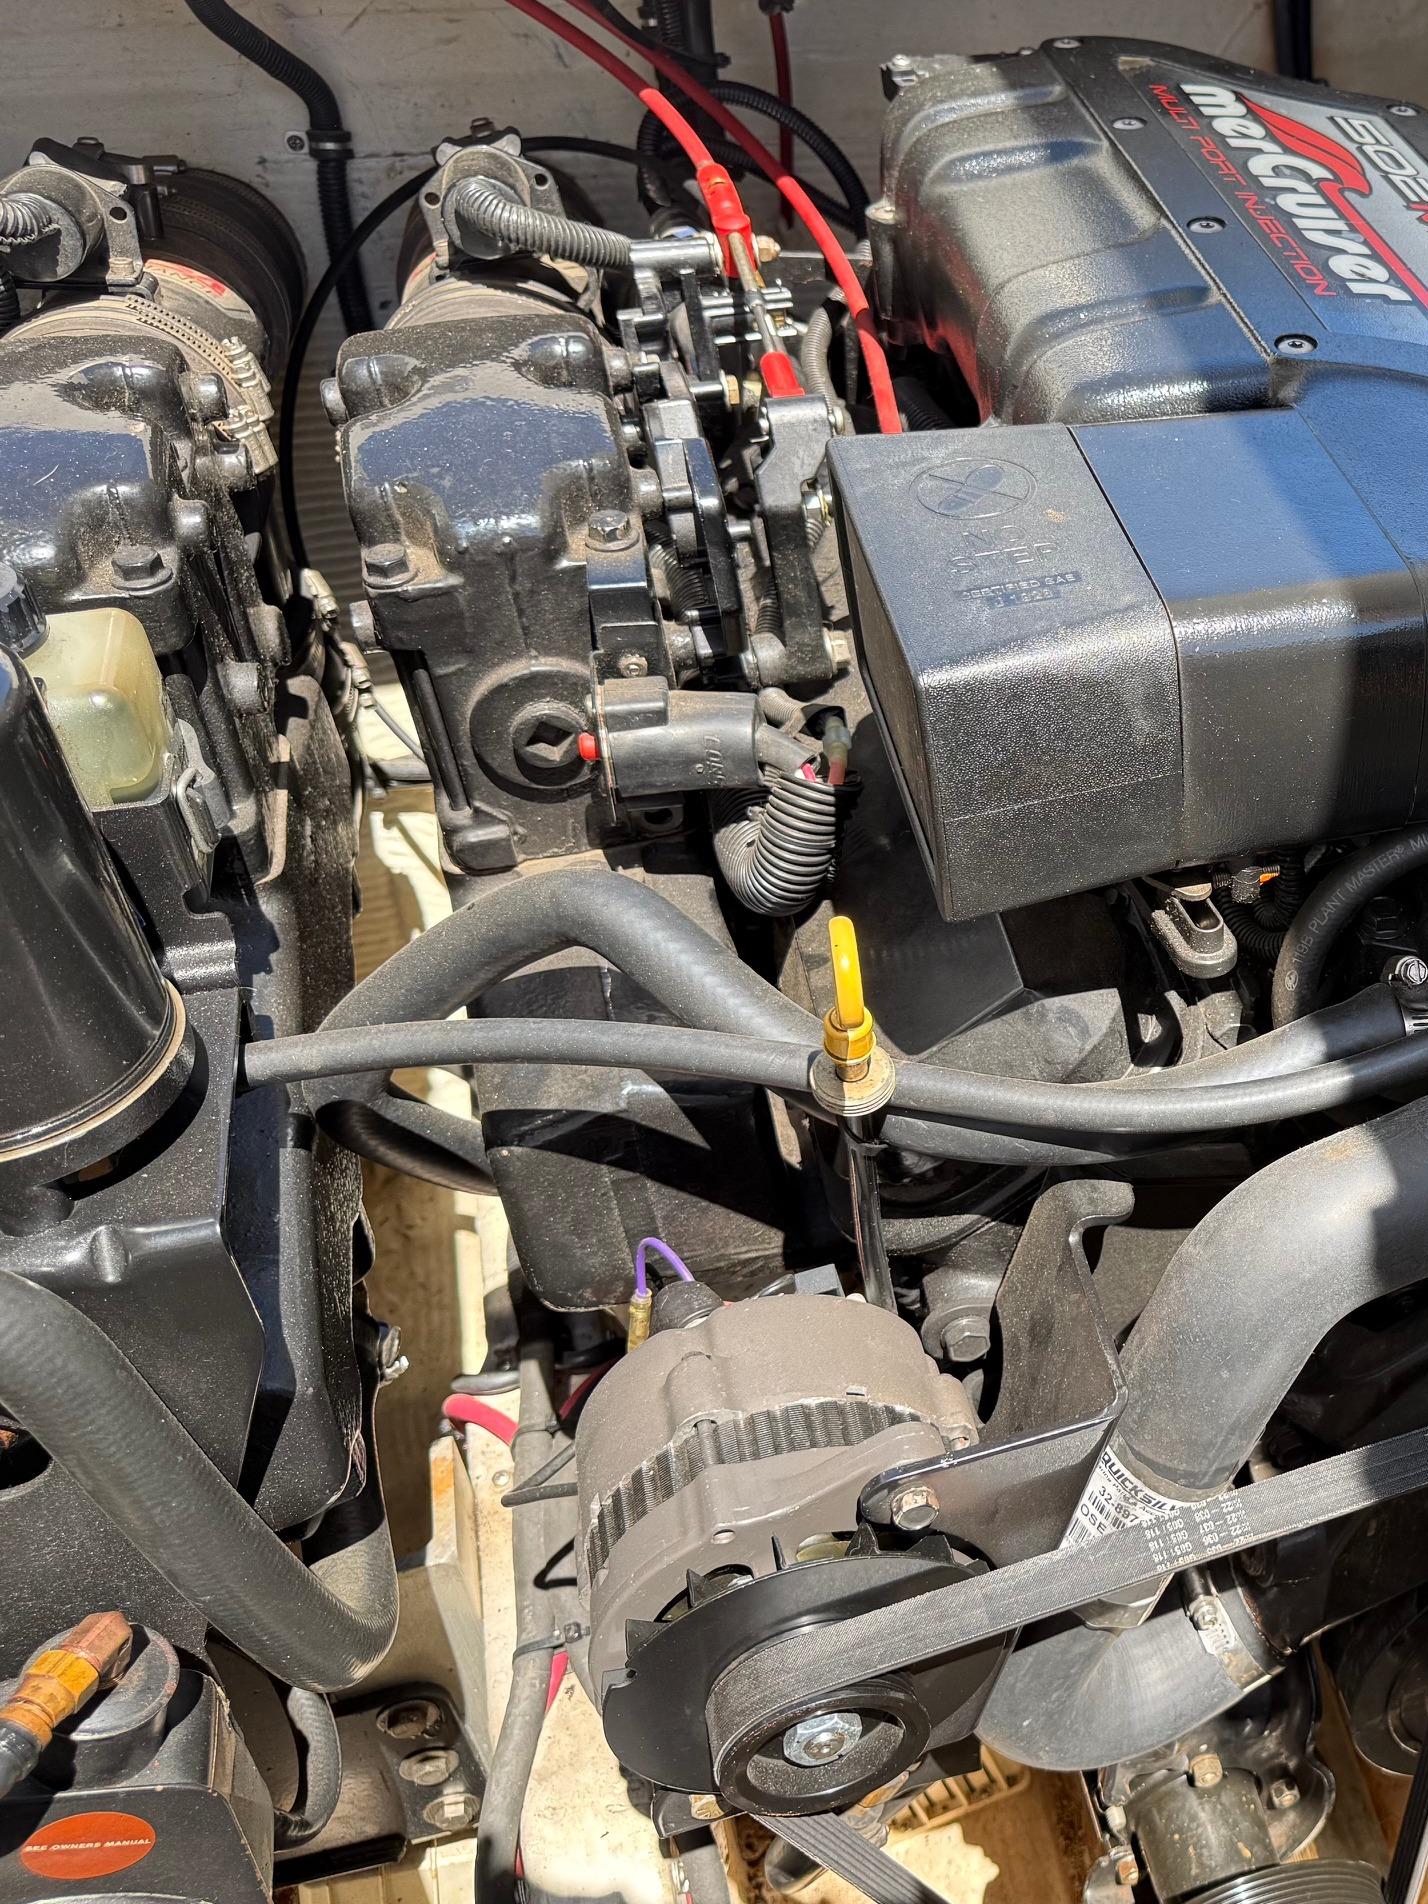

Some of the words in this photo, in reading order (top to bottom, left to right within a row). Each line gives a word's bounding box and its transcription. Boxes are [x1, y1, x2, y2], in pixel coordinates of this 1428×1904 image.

[1149, 84, 1201, 130] MULTI
[1190, 135, 1247, 187] PORT
[1235, 191, 1338, 297] INJECTION
[962, 525, 1027, 547] NO
[949, 542, 1058, 575] STEP
[1044, 573, 1077, 586] SAE
[1308, 888, 1346, 934] PLANT
[49, 1841, 101, 1850] OWNERS
[104, 1838, 151, 1848] MANUAL
